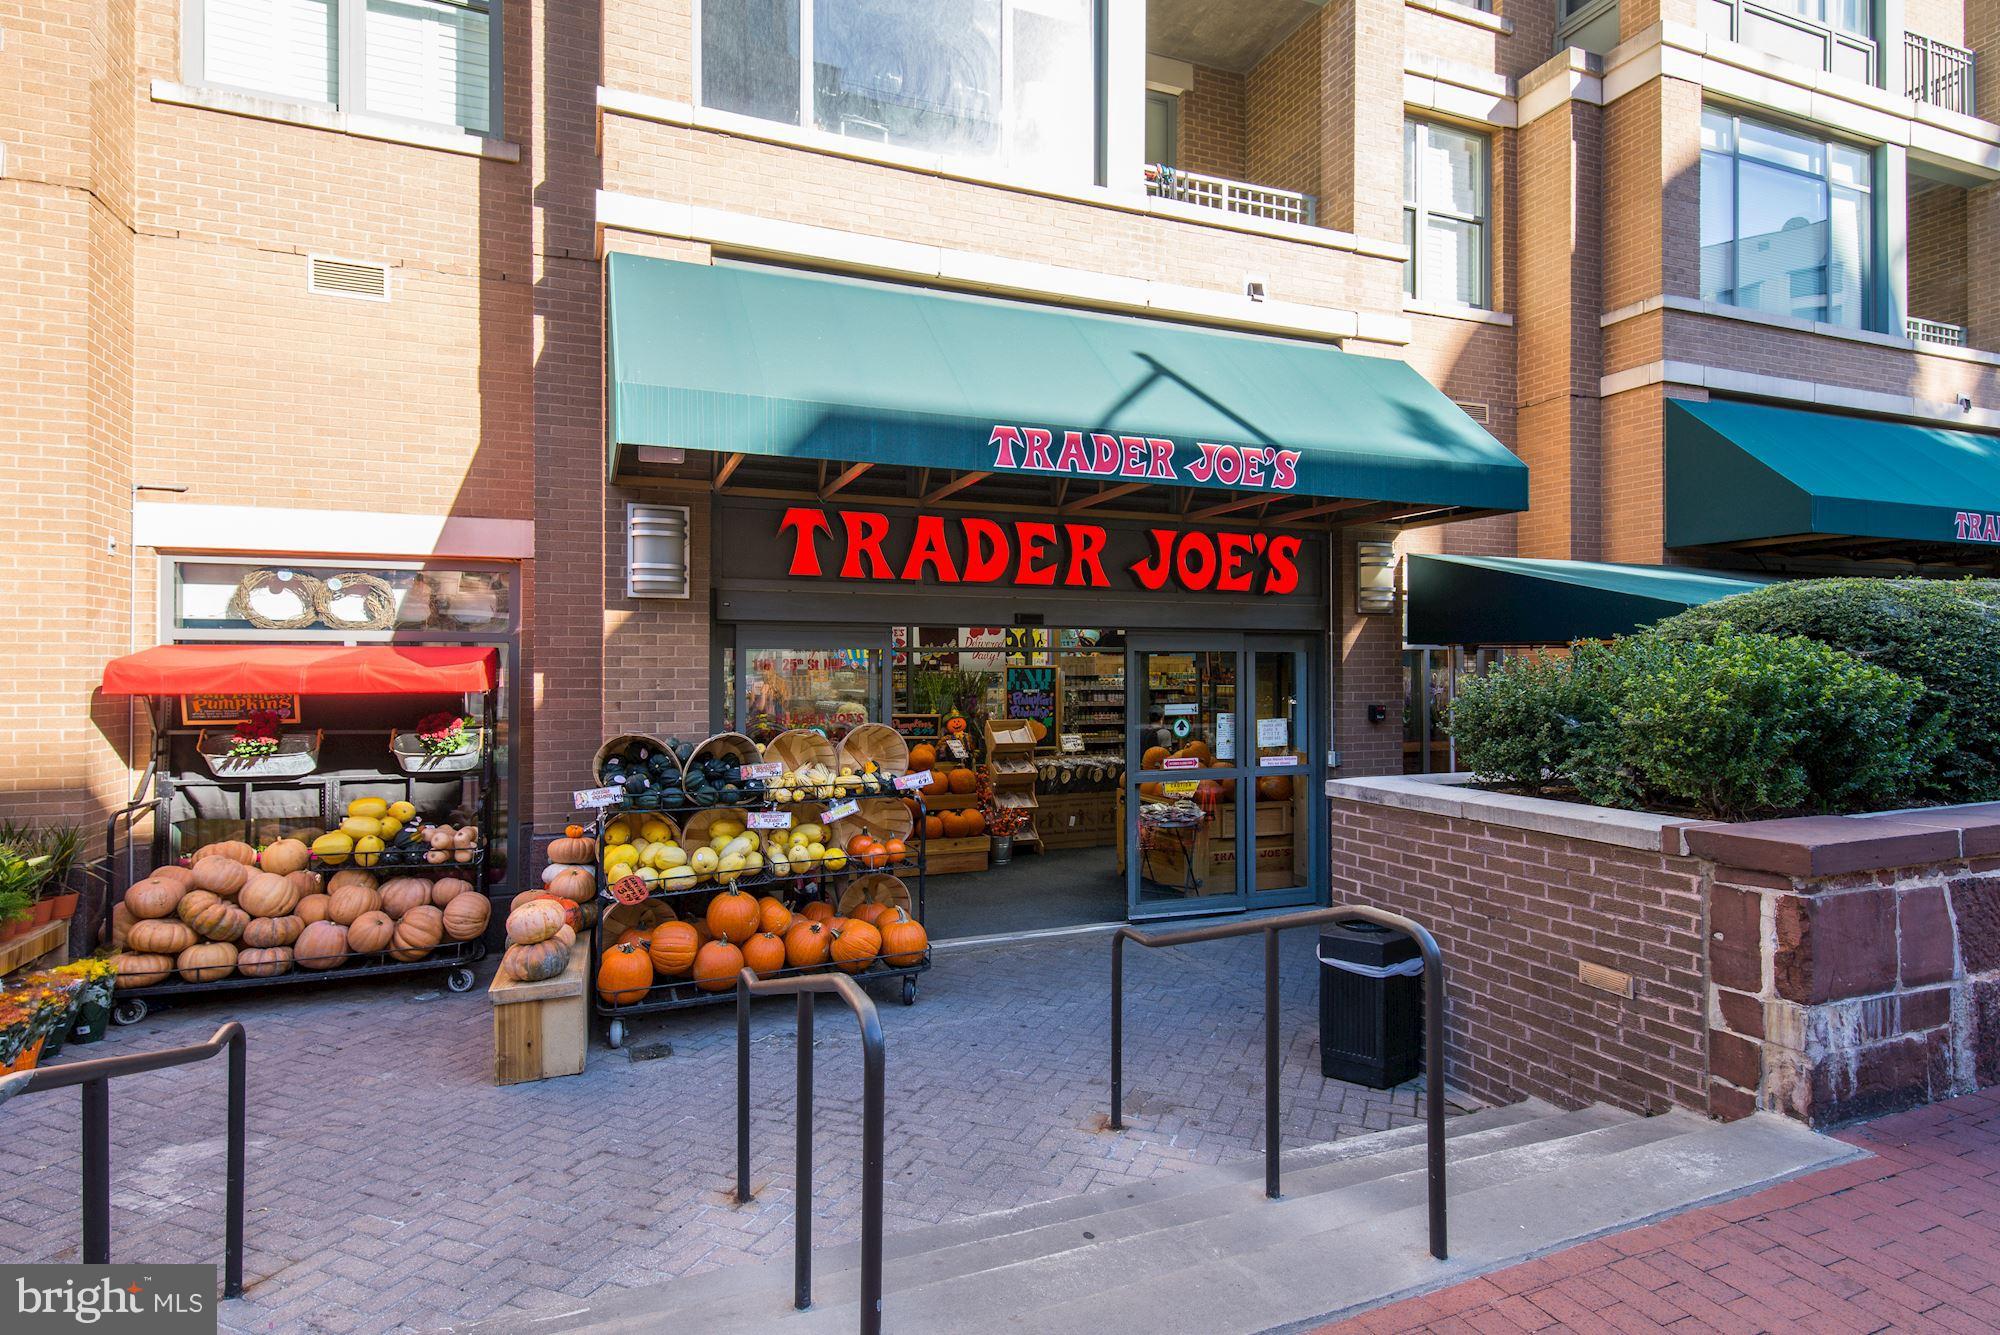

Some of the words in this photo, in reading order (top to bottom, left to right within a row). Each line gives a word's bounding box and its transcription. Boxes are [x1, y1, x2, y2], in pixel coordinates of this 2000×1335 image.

[988, 425, 1178, 480] TRADER
[1184, 442, 1302, 490] JOE'S
[1954, 512, 2000, 542] TRA
[775, 507, 1111, 588] TRADER
[1129, 528, 1302, 595] JOE'S
[192, 698, 292, 712] Pumpkins
[1260, 848, 1293, 858] JOE'S
